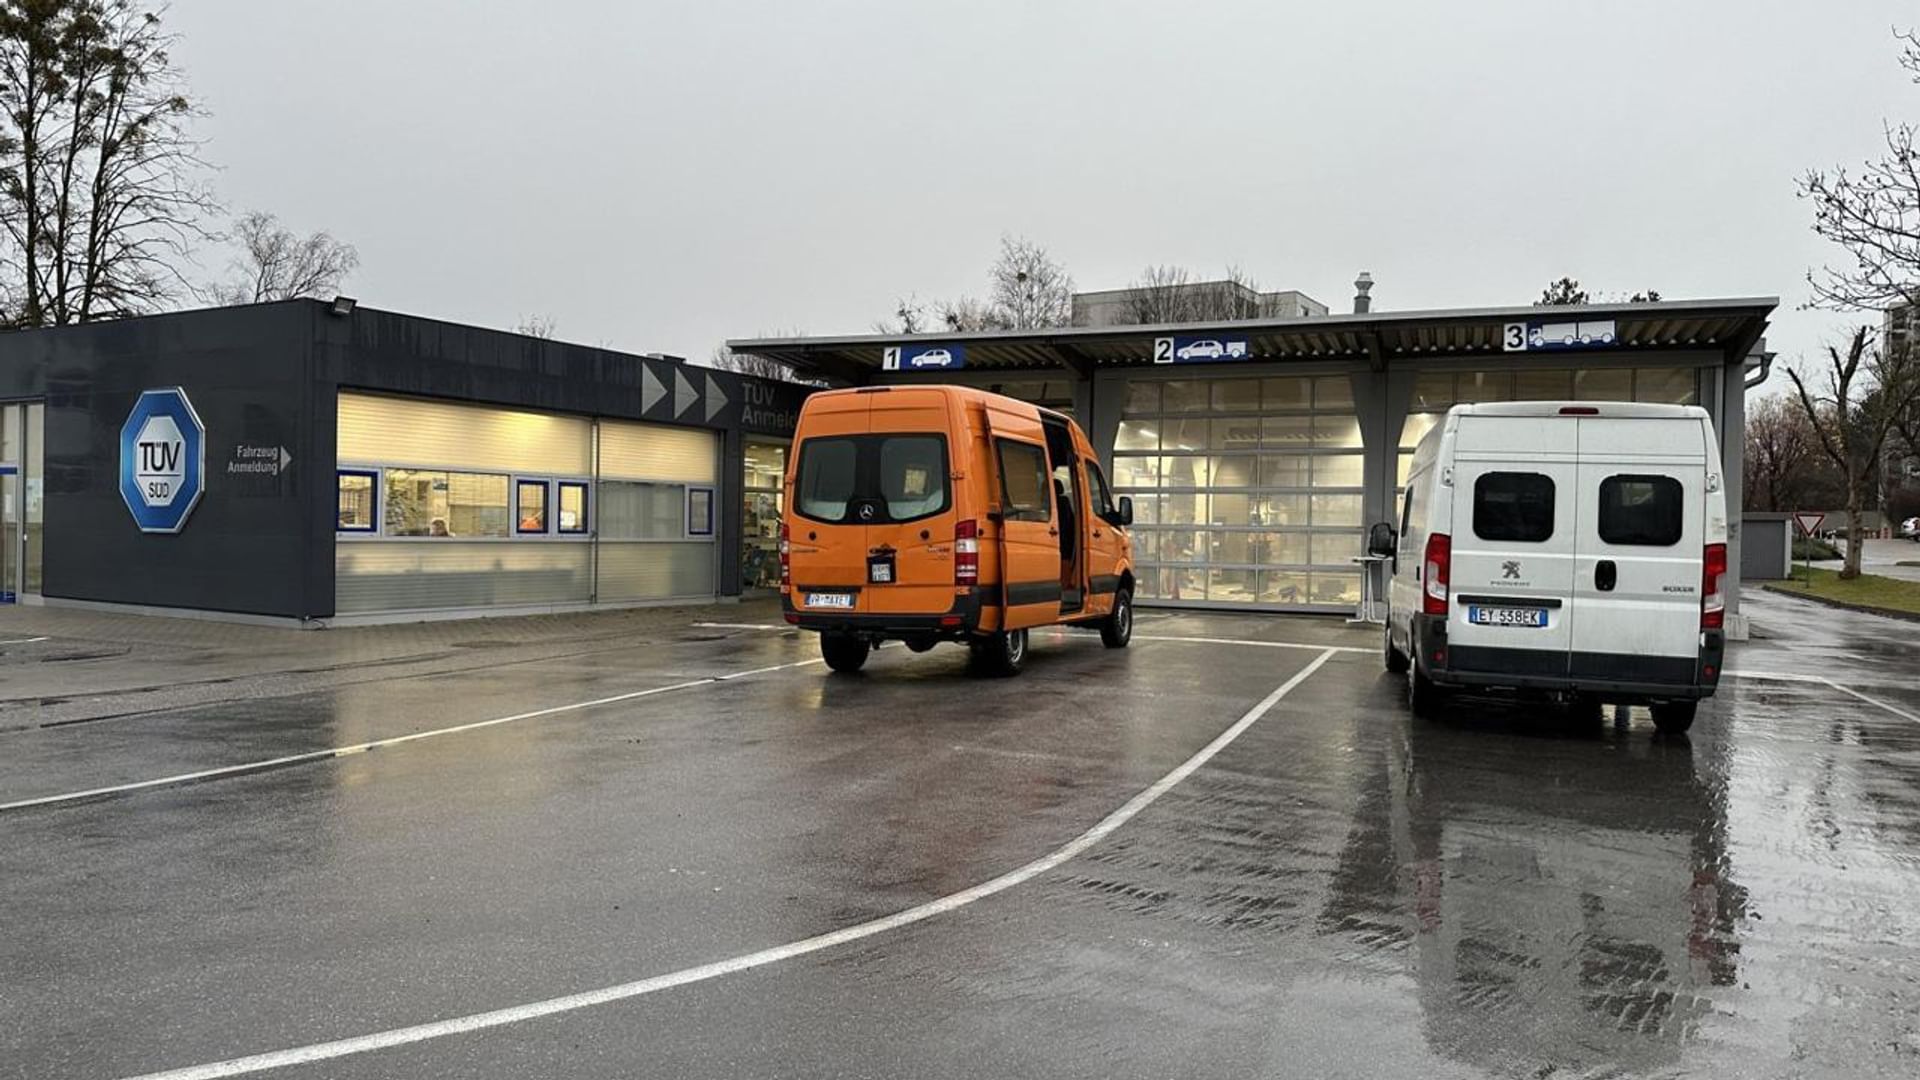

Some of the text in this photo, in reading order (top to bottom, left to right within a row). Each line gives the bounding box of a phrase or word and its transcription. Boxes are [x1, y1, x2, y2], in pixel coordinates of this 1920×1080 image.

[1507, 325, 1523, 348] 3
[888, 349, 896, 368] 1
[1157, 340, 1171, 360] 2
[139, 442, 181, 471] TÜV
[237, 445, 278, 460] Fahrzeug
[228, 461, 278, 476] Anmeldung
[148, 482, 170, 498] SÜD
[1479, 608, 1494, 620] EY
